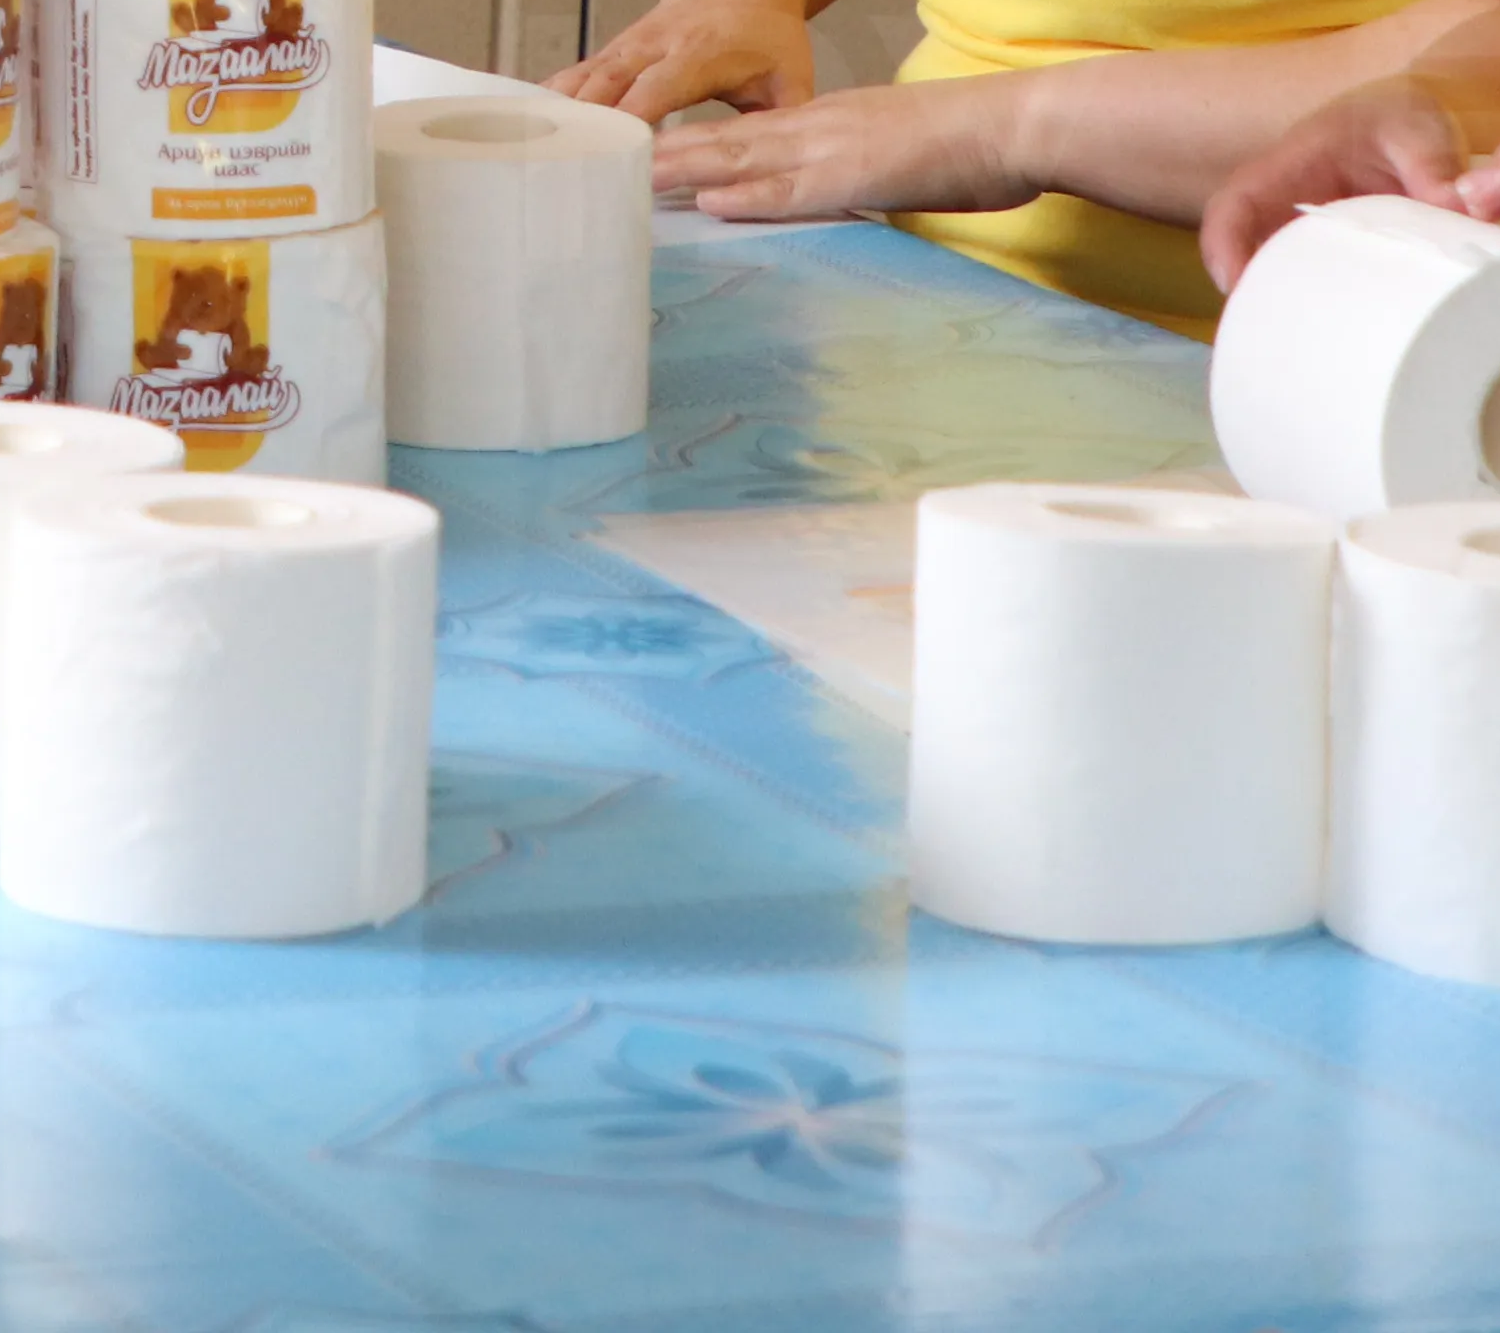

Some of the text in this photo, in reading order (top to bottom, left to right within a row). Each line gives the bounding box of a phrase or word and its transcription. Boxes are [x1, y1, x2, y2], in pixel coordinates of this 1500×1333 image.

[137, 23, 331, 127] Мазаалай
[229, 139, 312, 162] цэврийн
[213, 162, 262, 178] цаас
